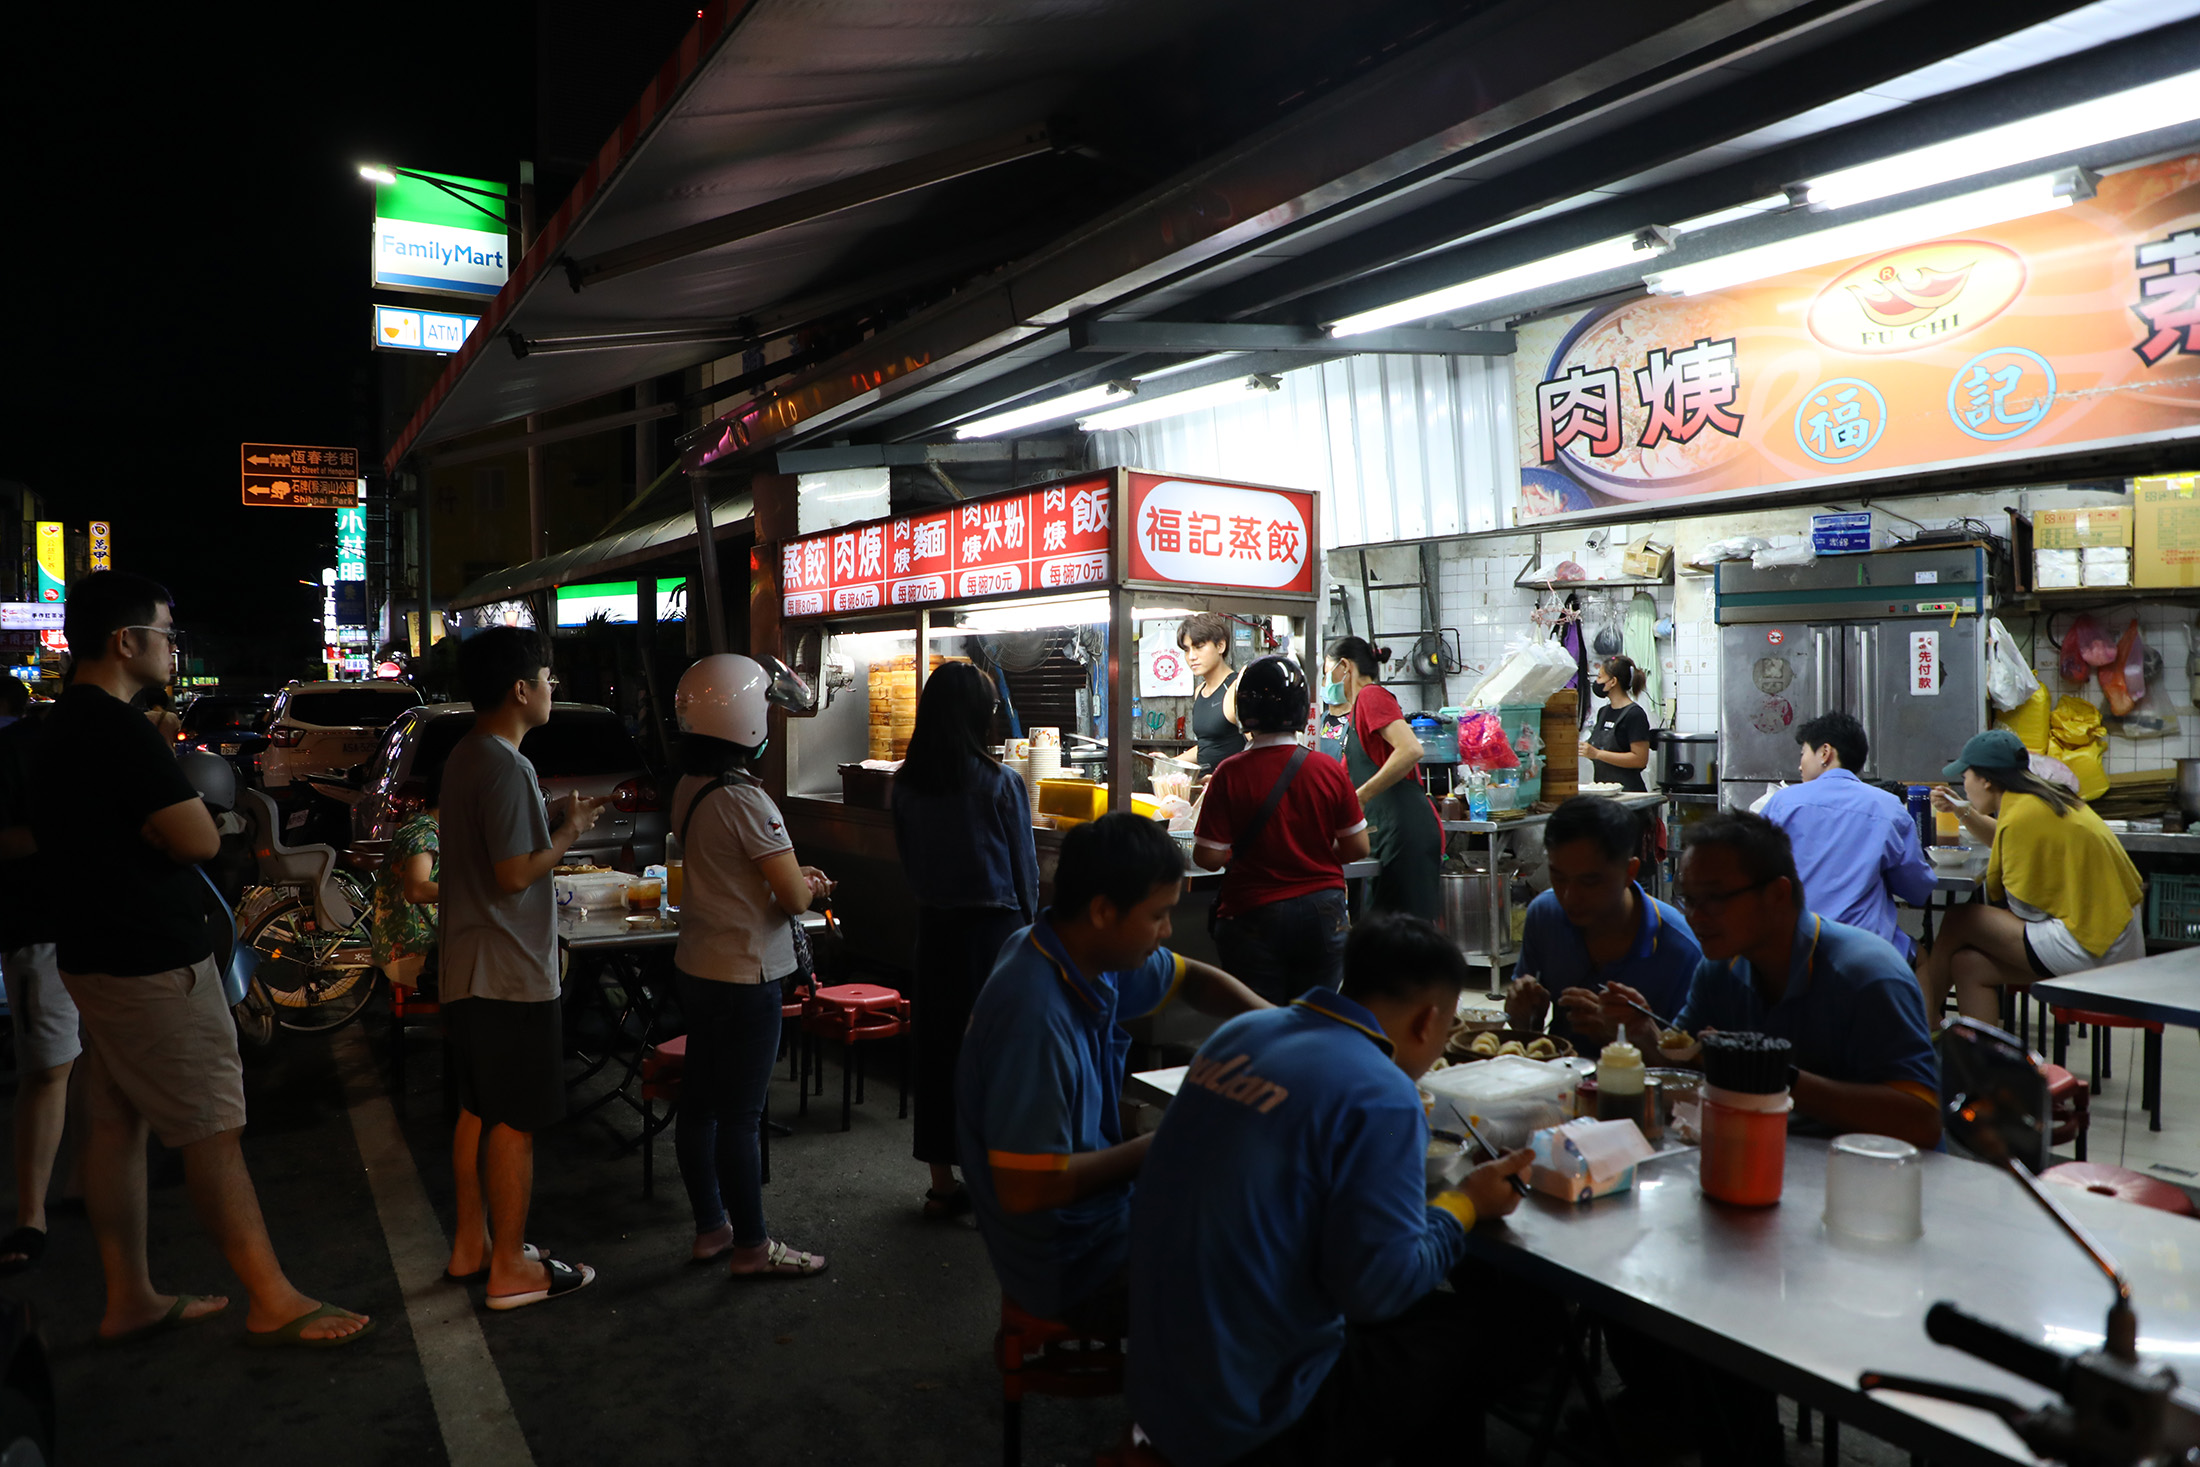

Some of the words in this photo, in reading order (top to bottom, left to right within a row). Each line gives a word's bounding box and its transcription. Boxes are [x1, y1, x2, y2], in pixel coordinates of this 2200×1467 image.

[382, 234, 503, 269] FamilyMart
[428, 324, 459, 341] ATM
[1861, 331, 1894, 345] FU
[1909, 313, 1961, 340] CHI
[1808, 387, 1870, 454] 福
[1963, 364, 2042, 429] 記
[291, 450, 355, 466] 恆春老街
[301, 465, 320, 474] Street
[293, 494, 328, 505] Shihpai
[332, 496, 354, 505] Park
[1146, 505, 1299, 565] 福記蒸餃
[783, 538, 826, 590] 蒸餃
[1049, 560, 1104, 586] 每碗70元
[897, 581, 938, 602] 每碗70元
[966, 572, 1013, 597] 每碗70元
[838, 590, 875, 611] 每碗60元
